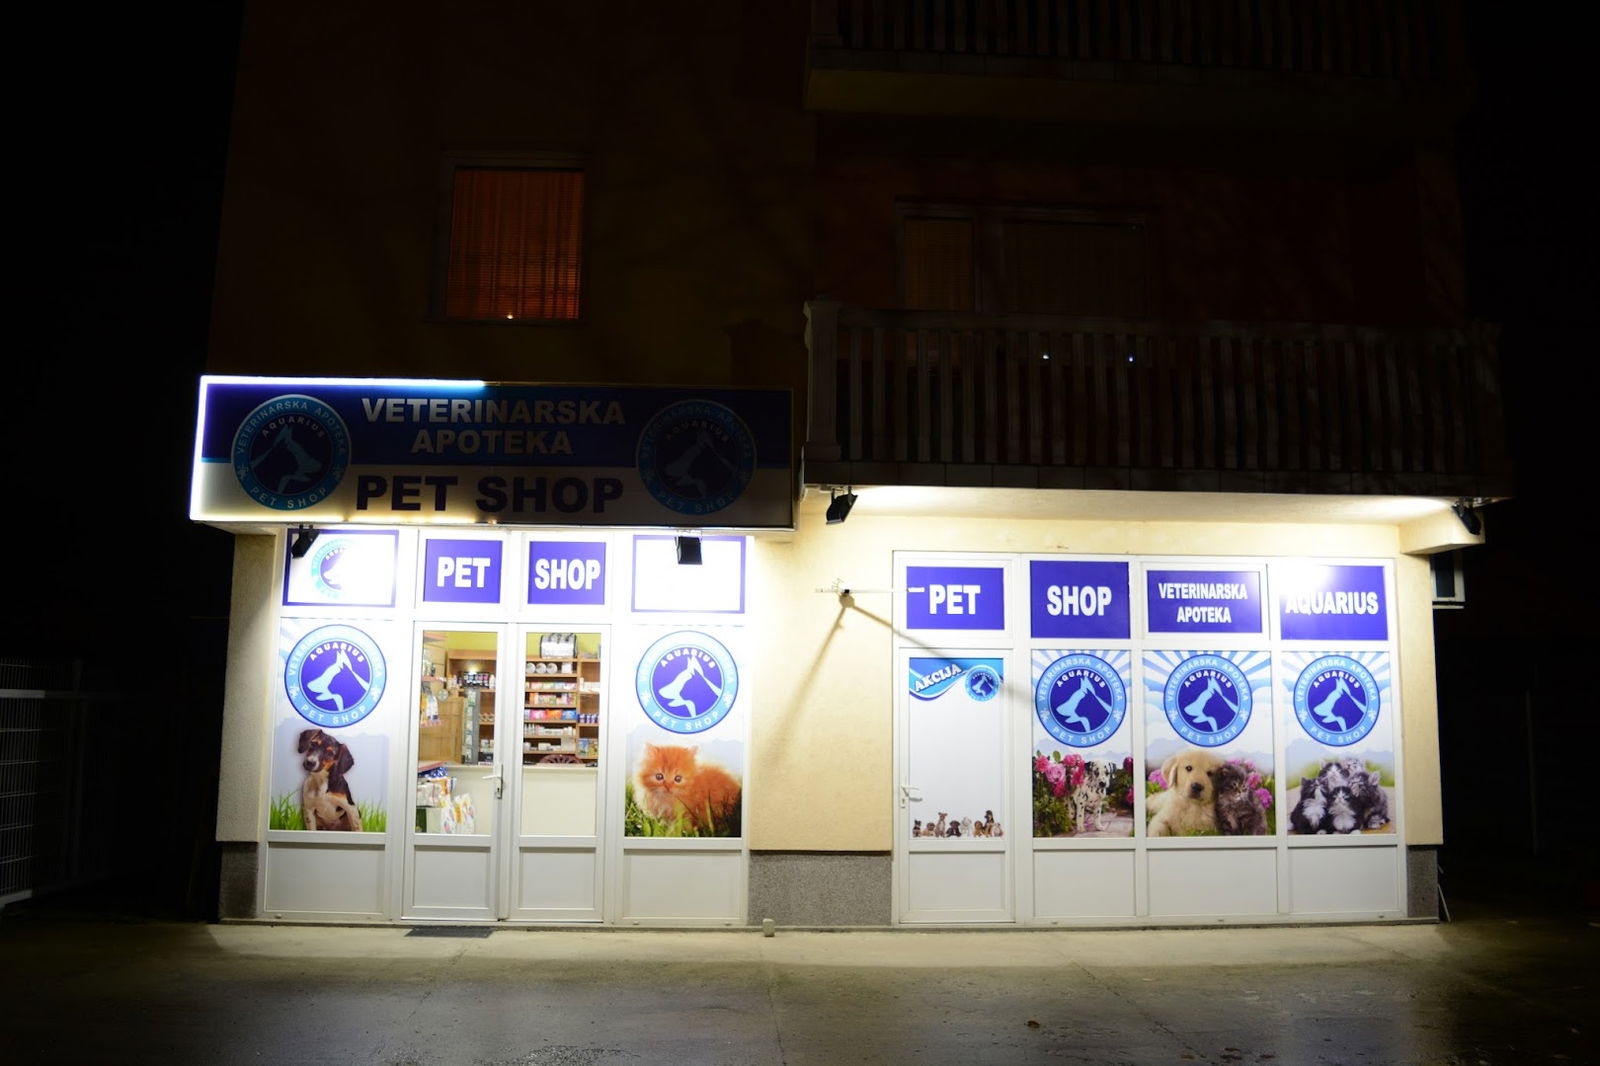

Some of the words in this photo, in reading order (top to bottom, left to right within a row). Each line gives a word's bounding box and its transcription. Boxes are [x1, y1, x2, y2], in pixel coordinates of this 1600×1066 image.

[362, 398, 625, 424] VETERINARSKA
[238, 400, 308, 453] VETERINARSKA
[262, 416, 325, 440] AQUARIUS
[411, 429, 574, 455] APOTEKA
[251, 487, 277, 506] PET
[287, 488, 326, 509] SHOP
[357, 475, 458, 511] PET
[476, 477, 624, 513] SHOP
[437, 556, 491, 588] PET
[534, 558, 600, 590] SHOP
[929, 584, 981, 614] PET
[1047, 585, 1112, 616] SHOP
[1158, 582, 1248, 600] VETERINARSKA
[1177, 606, 1232, 623] APOTEKA
[1285, 592, 1379, 616] AQUARIUS
[310, 642, 364, 663] AQUARIUS
[660, 648, 716, 668] AQUARIUS
[914, 664, 962, 692] AKCIJA
[1039, 658, 1092, 701] VETERINARSKA
[1095, 663, 1123, 700] APOTEKA
[1056, 670, 1105, 688] AQUARIUS
[1167, 658, 1217, 701] VETERINARSKA
[1222, 663, 1249, 700] APOTEKA
[1184, 670, 1232, 688] AQUARIUS
[1313, 671, 1360, 688] AQUARIUS
[301, 704, 325, 721] PET
[332, 705, 366, 725] SHOP
[653, 710, 678, 728] PET
[685, 711, 719, 731] SHOP
[1052, 726, 1075, 742] PET
[1081, 726, 1110, 745] SHOP
[1180, 726, 1201, 742] PET
[1208, 726, 1237, 744] SHOP
[1310, 726, 1331, 742] PET
[1337, 726, 1365, 743] SHOP
